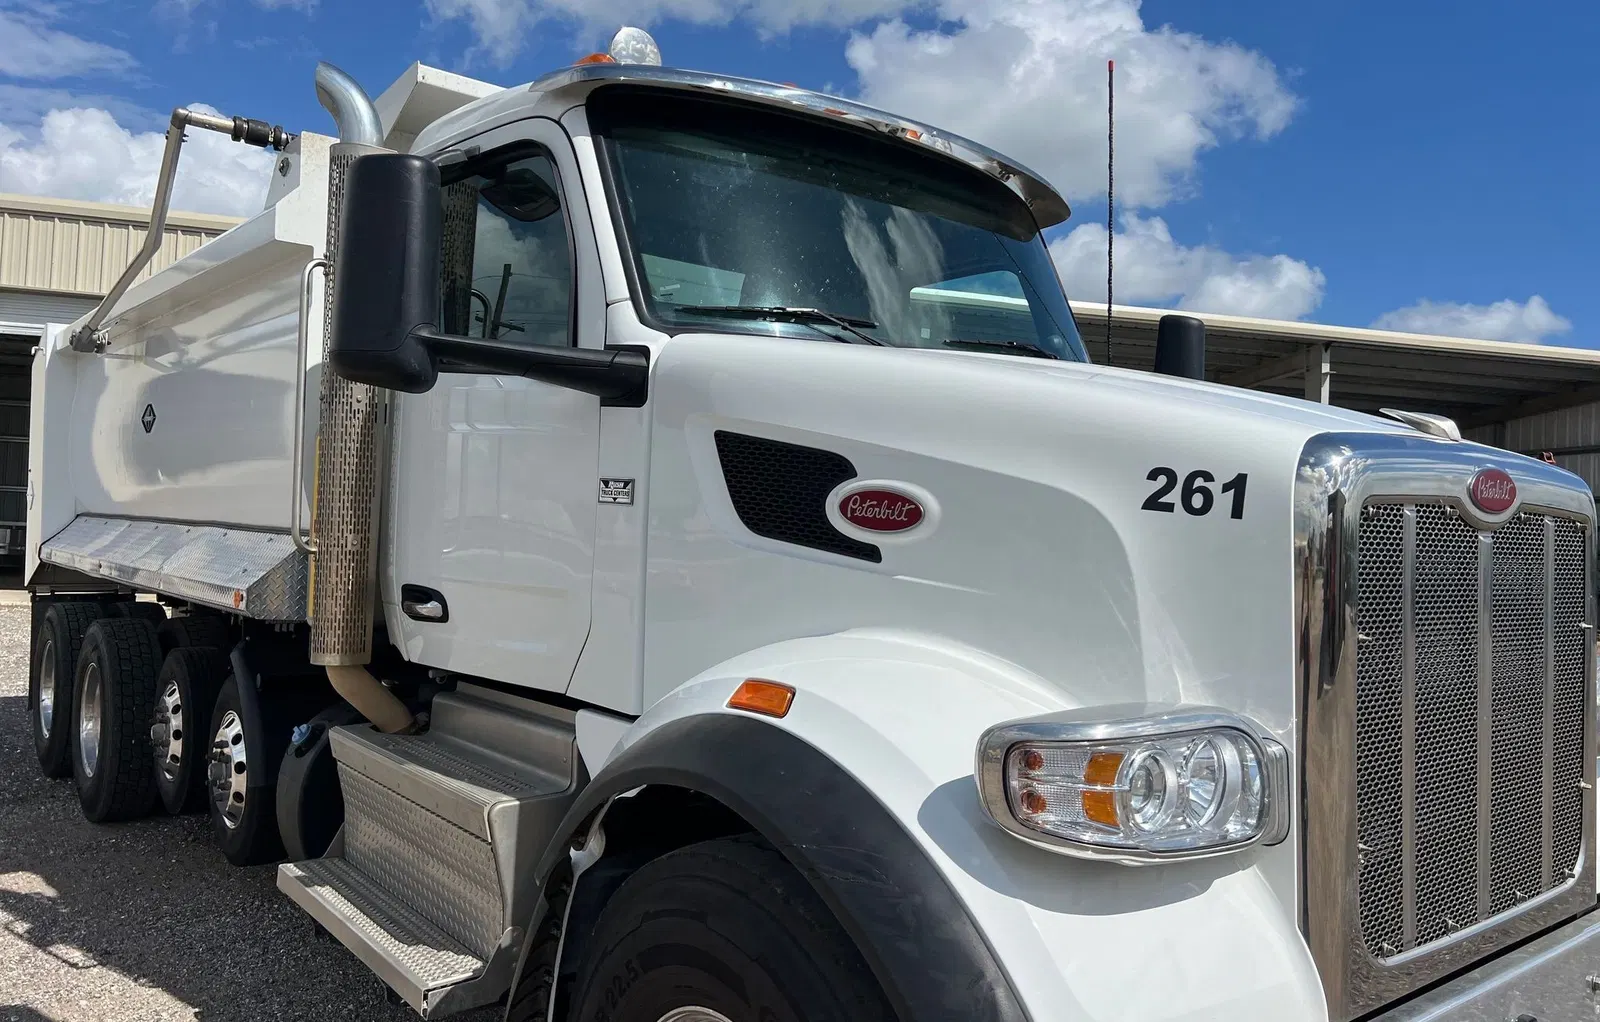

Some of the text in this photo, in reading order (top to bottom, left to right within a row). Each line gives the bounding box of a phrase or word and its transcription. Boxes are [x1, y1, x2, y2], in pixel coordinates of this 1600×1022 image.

[613, 489, 630, 497] CENTERS
[1141, 466, 1248, 520] 261
[1477, 475, 1514, 500] Peterbilt
[847, 495, 915, 521] Peterbilt
